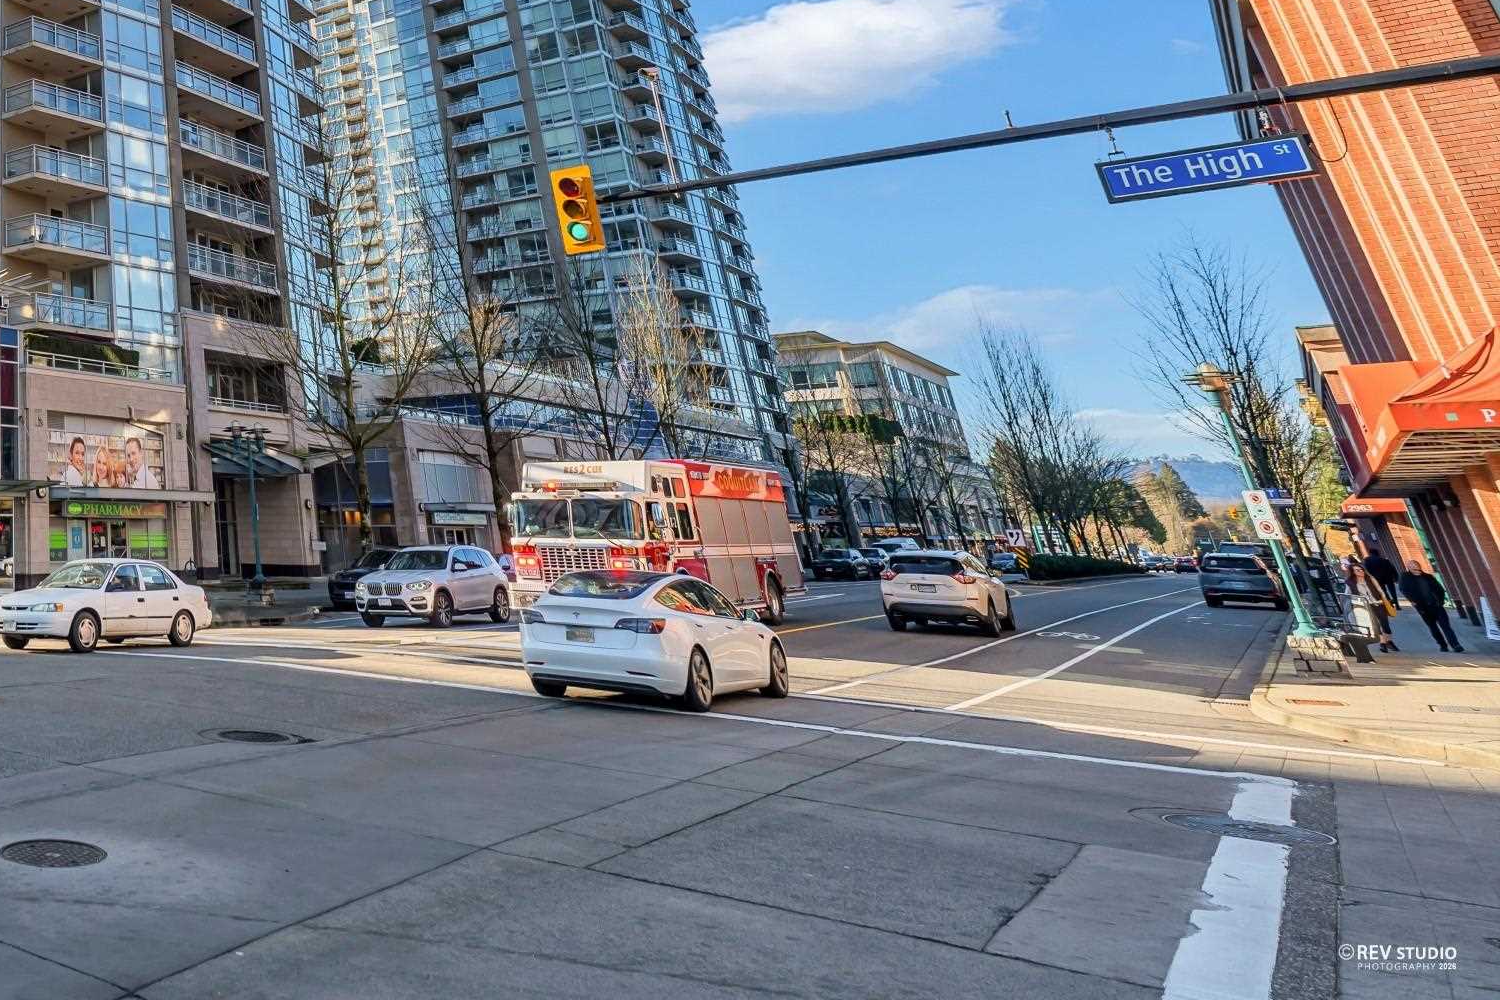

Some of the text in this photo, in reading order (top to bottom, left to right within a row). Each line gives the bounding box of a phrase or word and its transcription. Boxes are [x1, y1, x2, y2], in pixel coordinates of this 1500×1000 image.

[1113, 144, 1291, 188] The High St
[83, 503, 142, 515] PHARMACY
